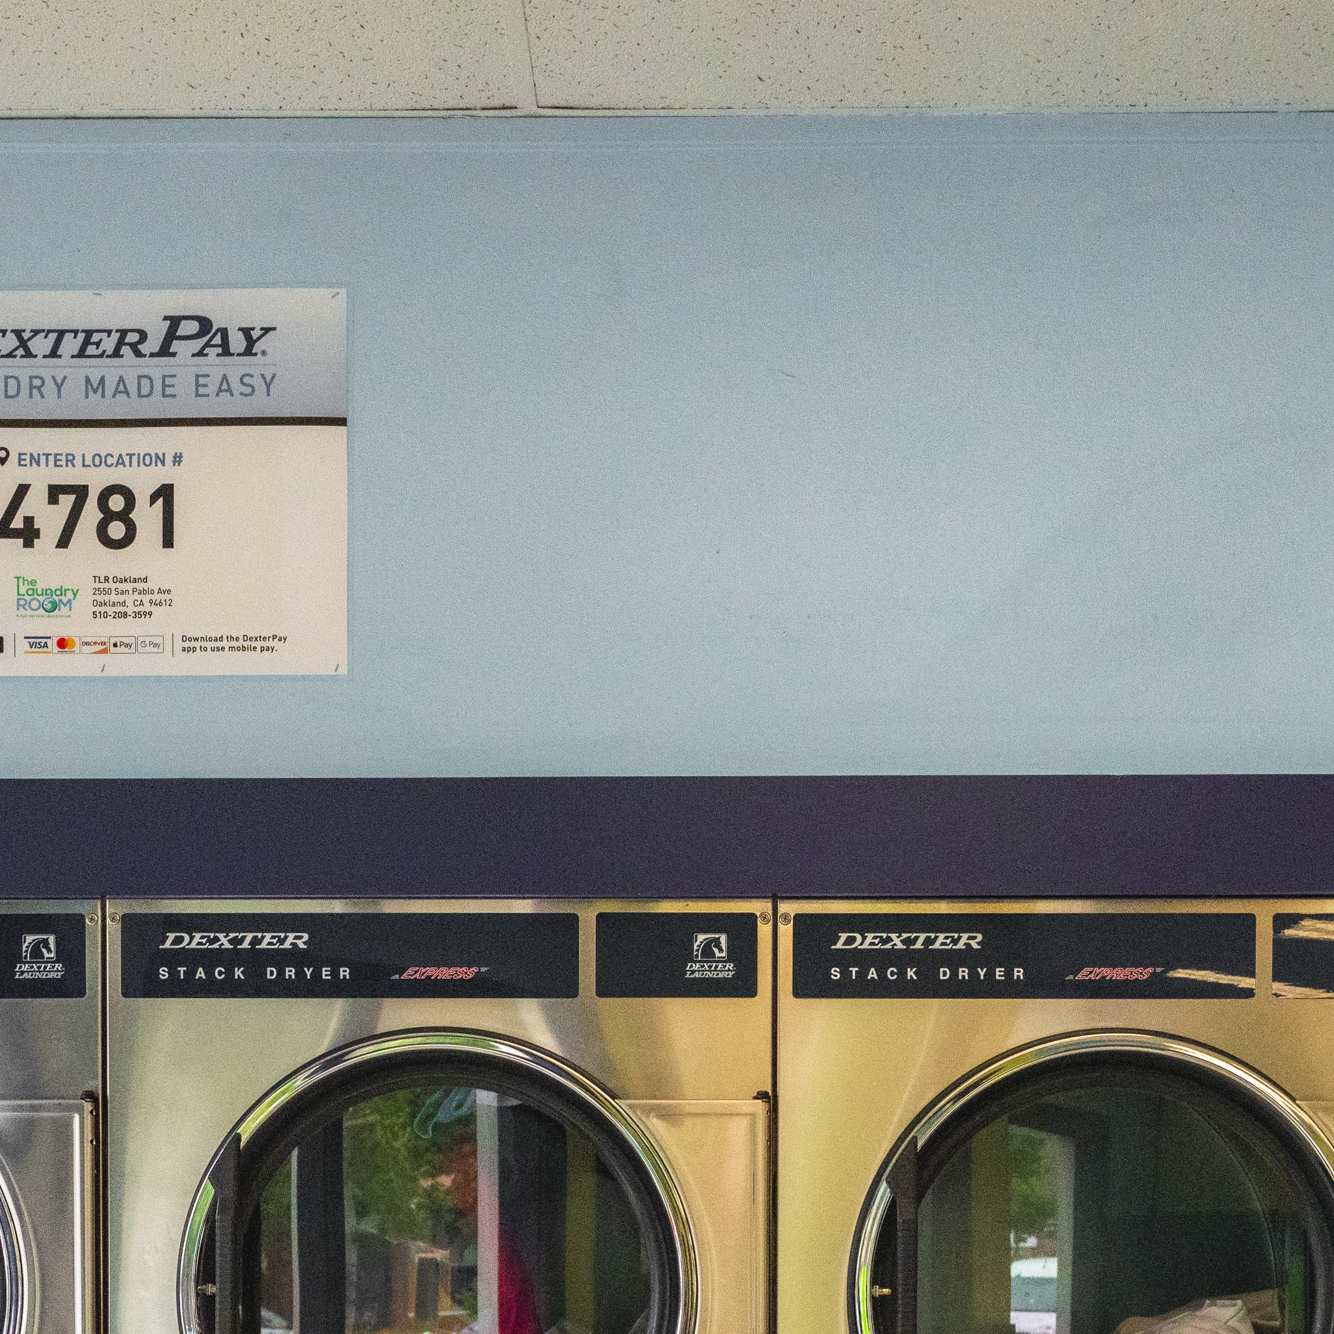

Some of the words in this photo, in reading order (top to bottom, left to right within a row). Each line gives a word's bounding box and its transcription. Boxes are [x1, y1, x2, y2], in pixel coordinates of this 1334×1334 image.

[84, 373, 177, 400] MADE
[194, 372, 277, 398] EASY
[17, 452, 76, 468] ENTER
[81, 452, 166, 469] LOCATION
[171, 452, 184, 467] #
[13, 574, 39, 589] The
[92, 574, 110, 584] TLR
[112, 575, 148, 584] Oakland
[16, 585, 81, 600] Laundry
[92, 586, 112, 596] 2550
[114, 586, 130, 596] San
[131, 586, 155, 596] Pablo
[156, 586, 172, 595] Ave
[92, 598, 127, 608] Oakland,
[132, 598, 145, 608] CA
[148, 598, 174, 607] 94612
[92, 609, 153, 619] 510-208-3599
[181, 634, 224, 643] Download
[225, 634, 240, 643] the
[242, 633, 288, 643] DexterPay
[28, 641, 49, 650] VISA
[181, 646, 198, 655] app
[199, 645, 208, 653] to
[210, 645, 226, 653] use
[227, 643, 258, 652] mobile
[259, 645, 278, 653] pay.
[159, 932, 309, 949] DEXTER
[831, 932, 983, 949] DEXTER
[15, 962, 63, 972] DEXTER
[686, 961, 734, 971] DEXTER
[158, 966, 245, 980] STACK
[266, 966, 350, 980] DRYER
[831, 966, 917, 980] STACK
[939, 966, 1024, 980] DRYER
